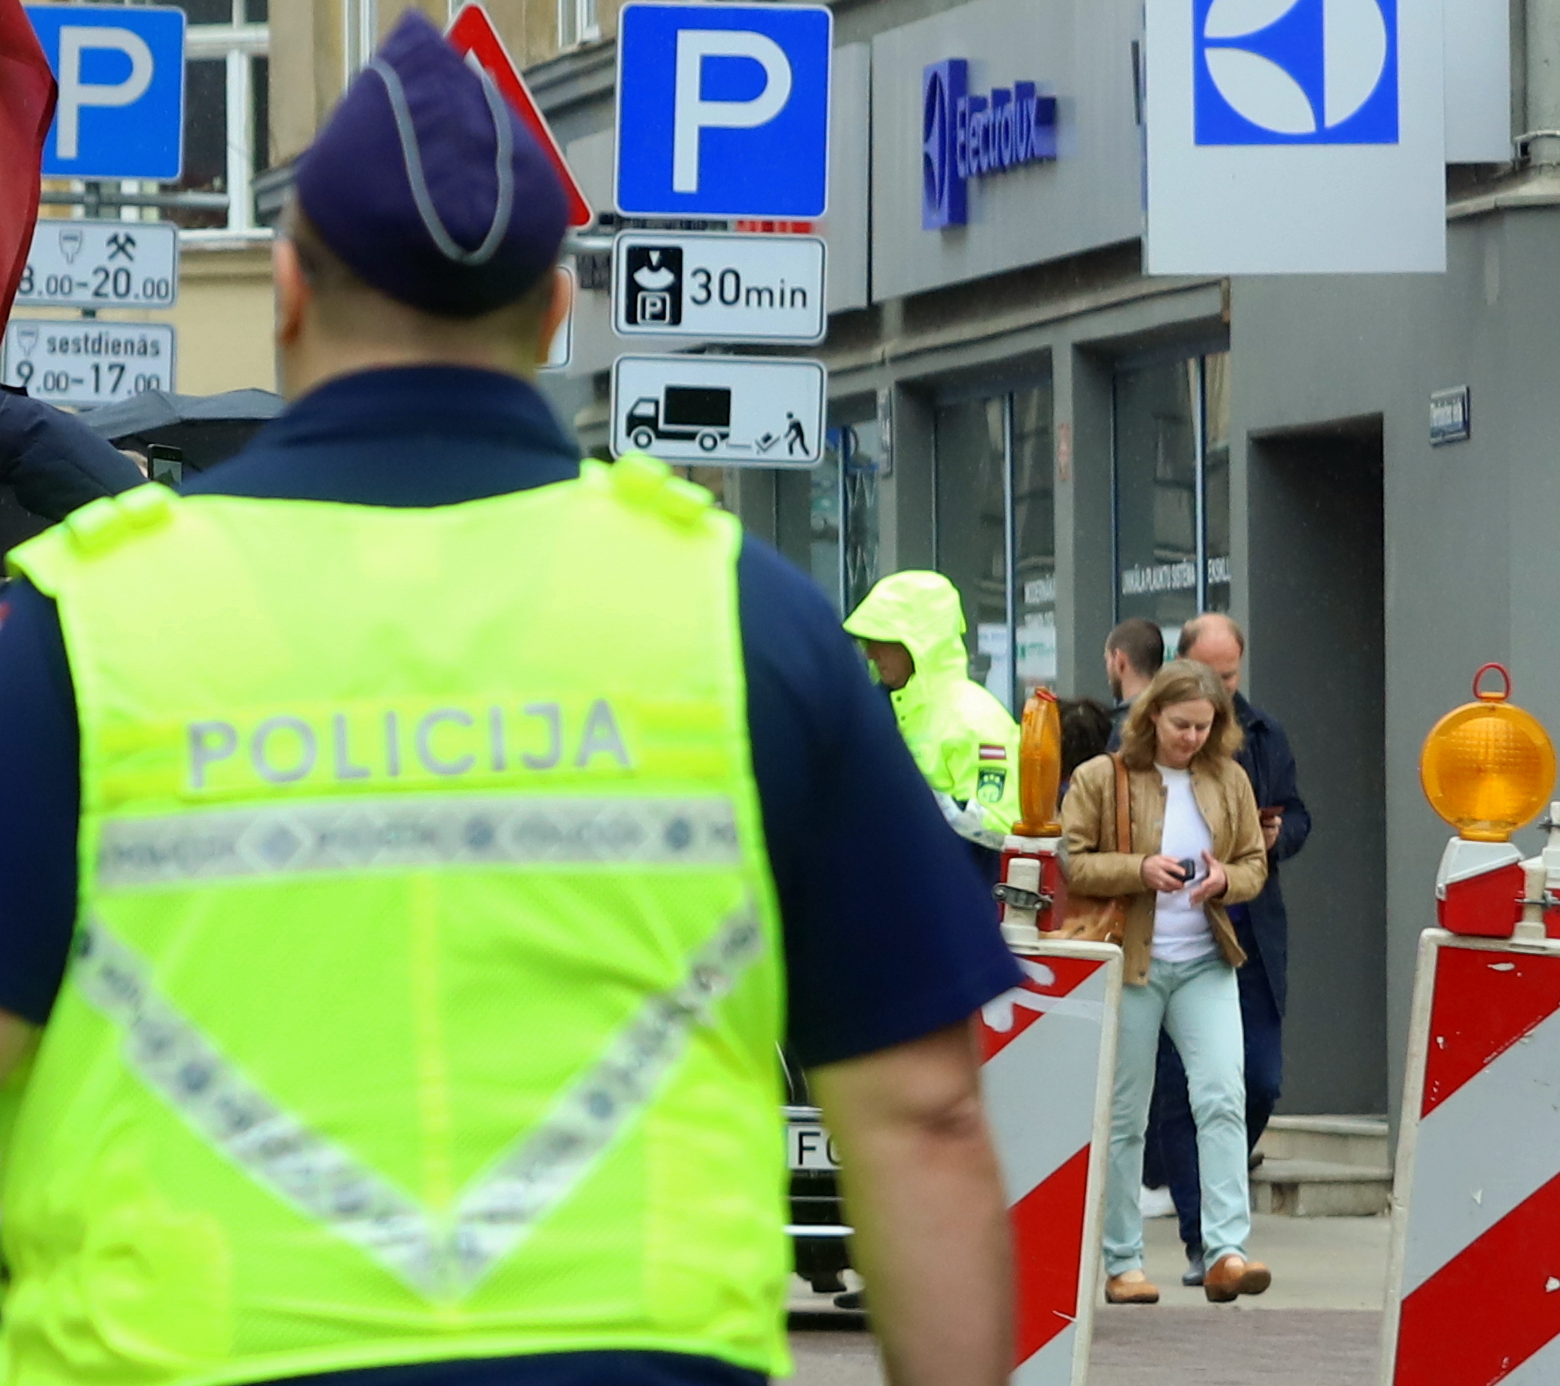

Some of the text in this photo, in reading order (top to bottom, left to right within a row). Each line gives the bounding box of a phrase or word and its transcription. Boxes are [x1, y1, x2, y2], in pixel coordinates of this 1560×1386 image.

[56, 24, 155, 160] P
[672, 28, 793, 194] P
[956, 95, 1036, 180] Electrolux
[689, 267, 808, 311] 30min
[46, 330, 161, 358] sestdienās
[187, 699, 633, 790] POLICIJA
